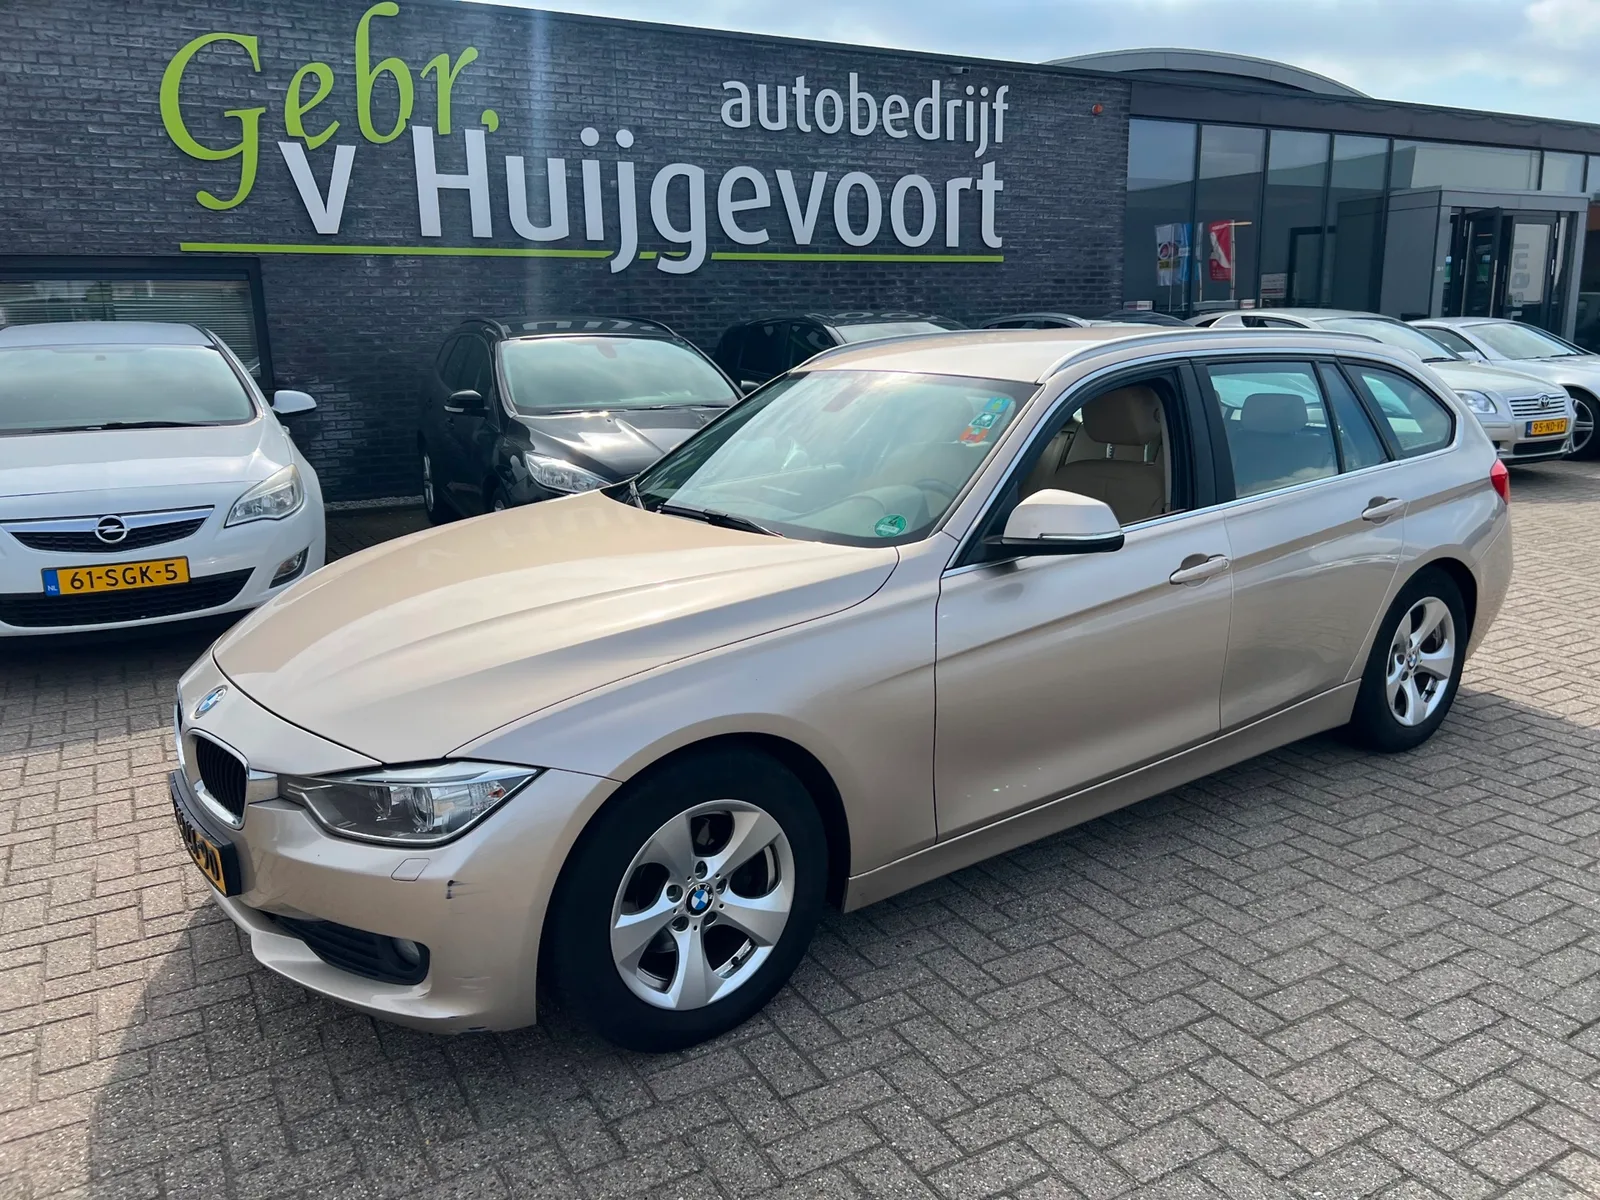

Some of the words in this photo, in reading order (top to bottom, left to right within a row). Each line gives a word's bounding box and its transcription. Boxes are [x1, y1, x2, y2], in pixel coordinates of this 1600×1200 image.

[160, 2, 499, 210] Gebr.
[720, 71, 1009, 159] autobedrijf
[277, 140, 357, 235] v
[411, 124, 1005, 275] Huijgevoort
[70, 563, 178, 590] 61-SGK-5
